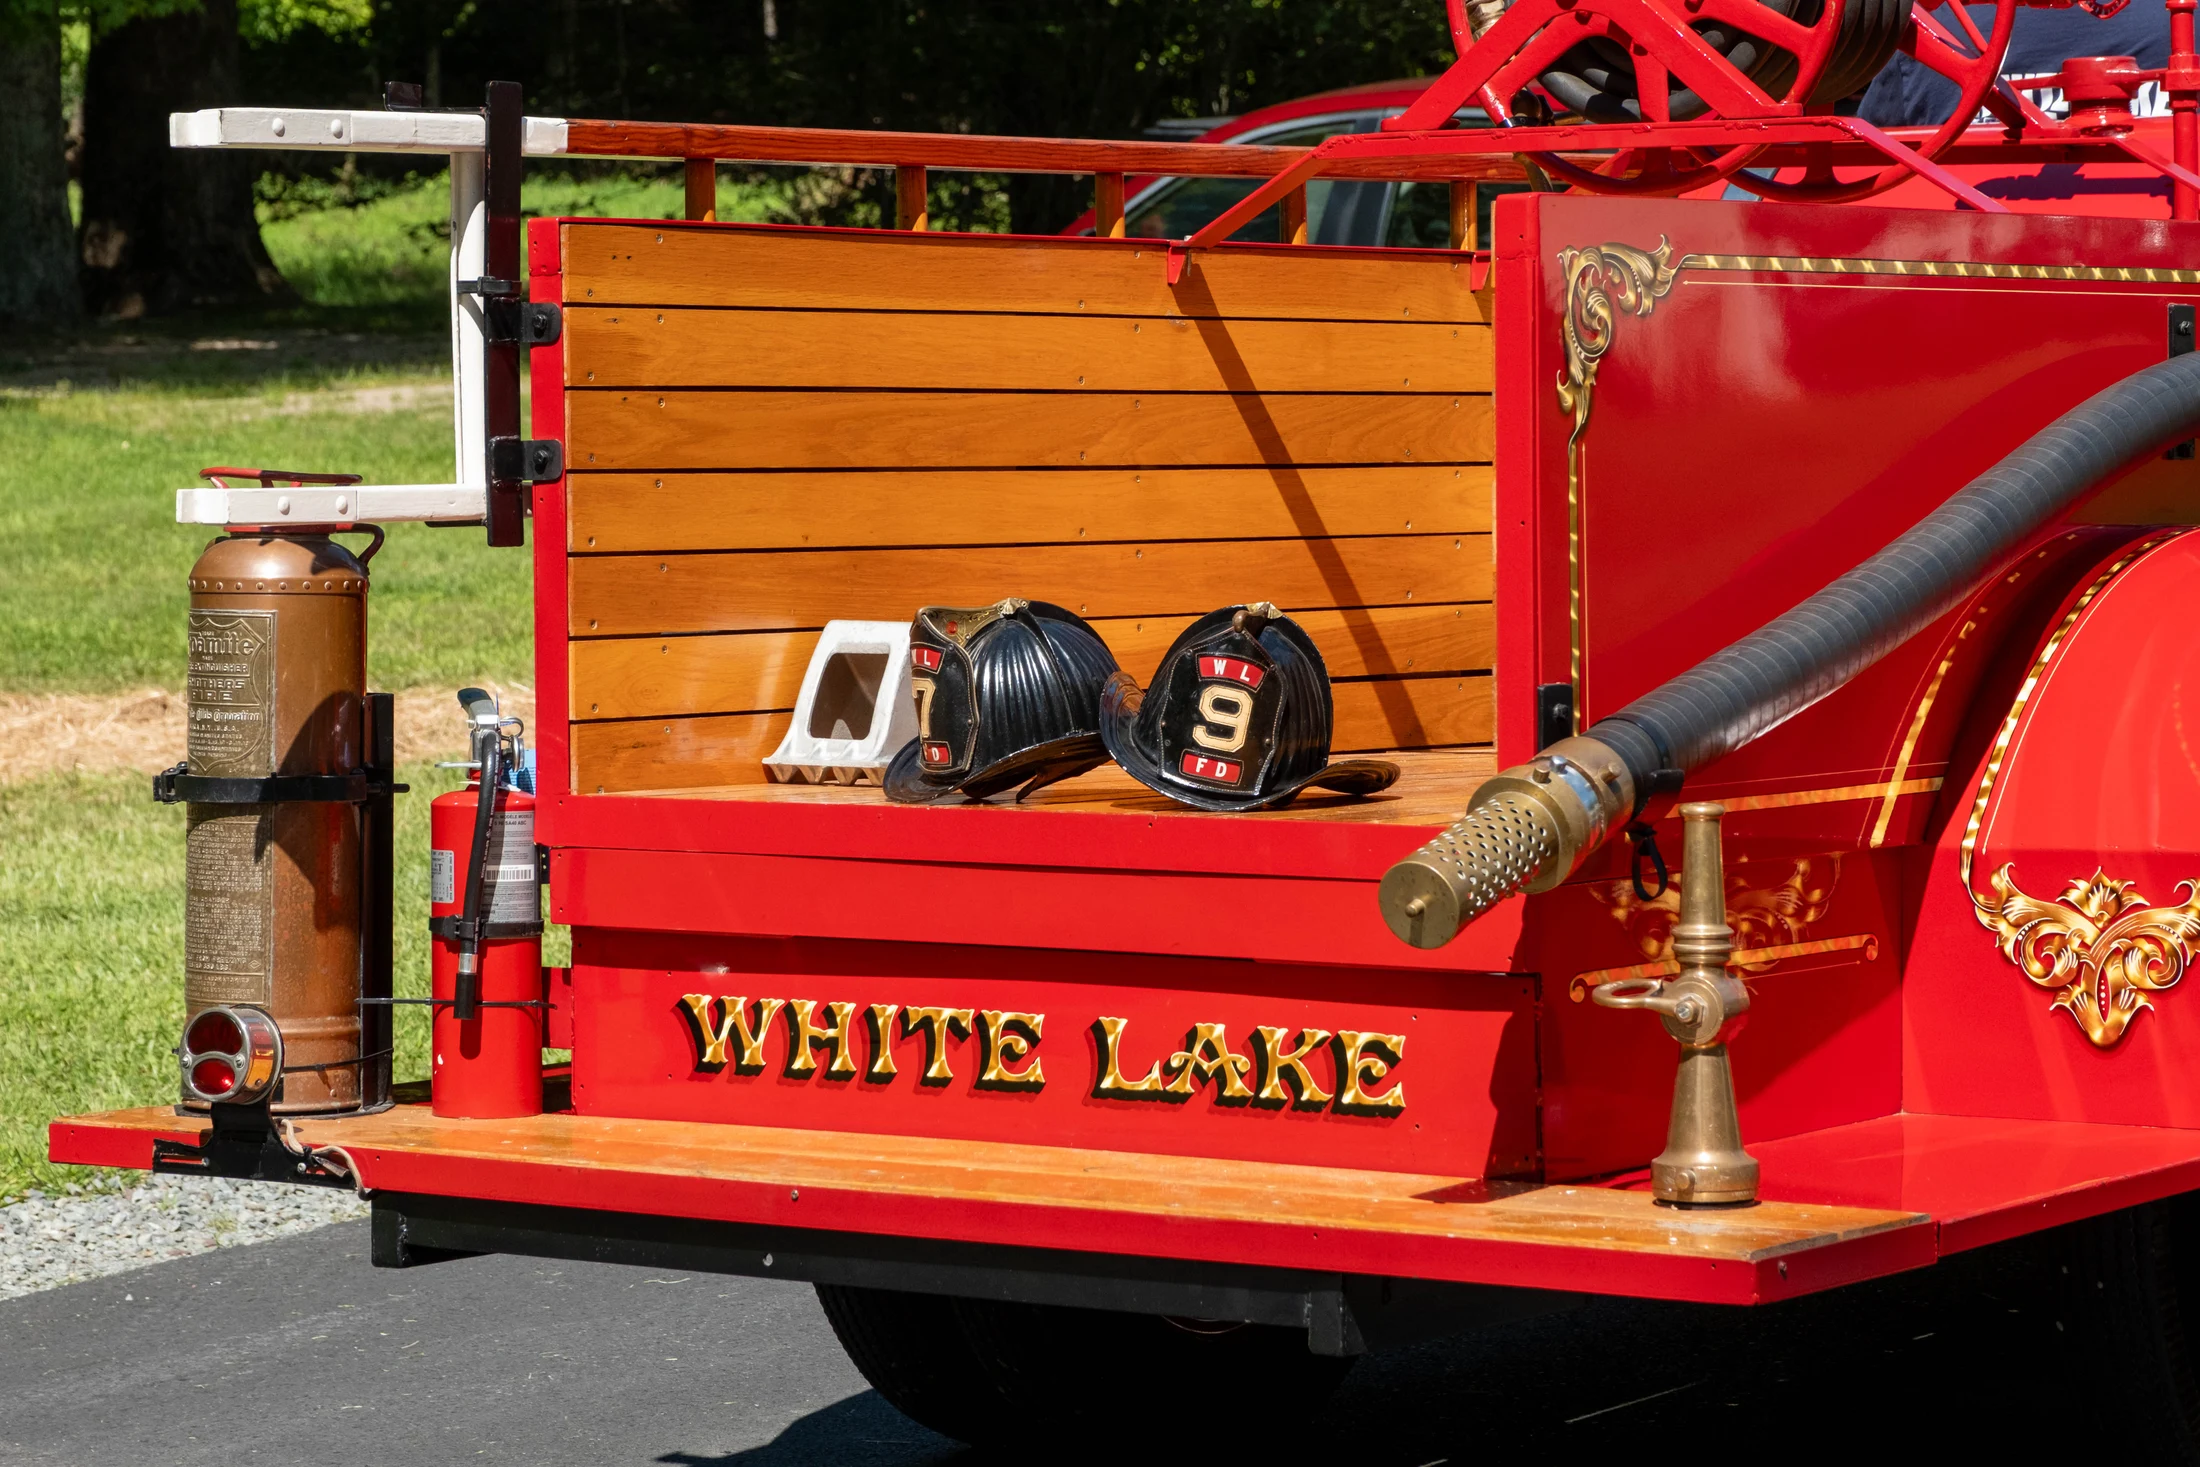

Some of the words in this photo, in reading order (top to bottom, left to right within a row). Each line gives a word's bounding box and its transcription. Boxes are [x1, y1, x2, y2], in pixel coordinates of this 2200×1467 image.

[912, 677, 936, 738] 7
[1192, 685, 1253, 753] 9
[676, 993, 1046, 1093] WHITE
[1091, 1016, 1407, 1119] LAKE
